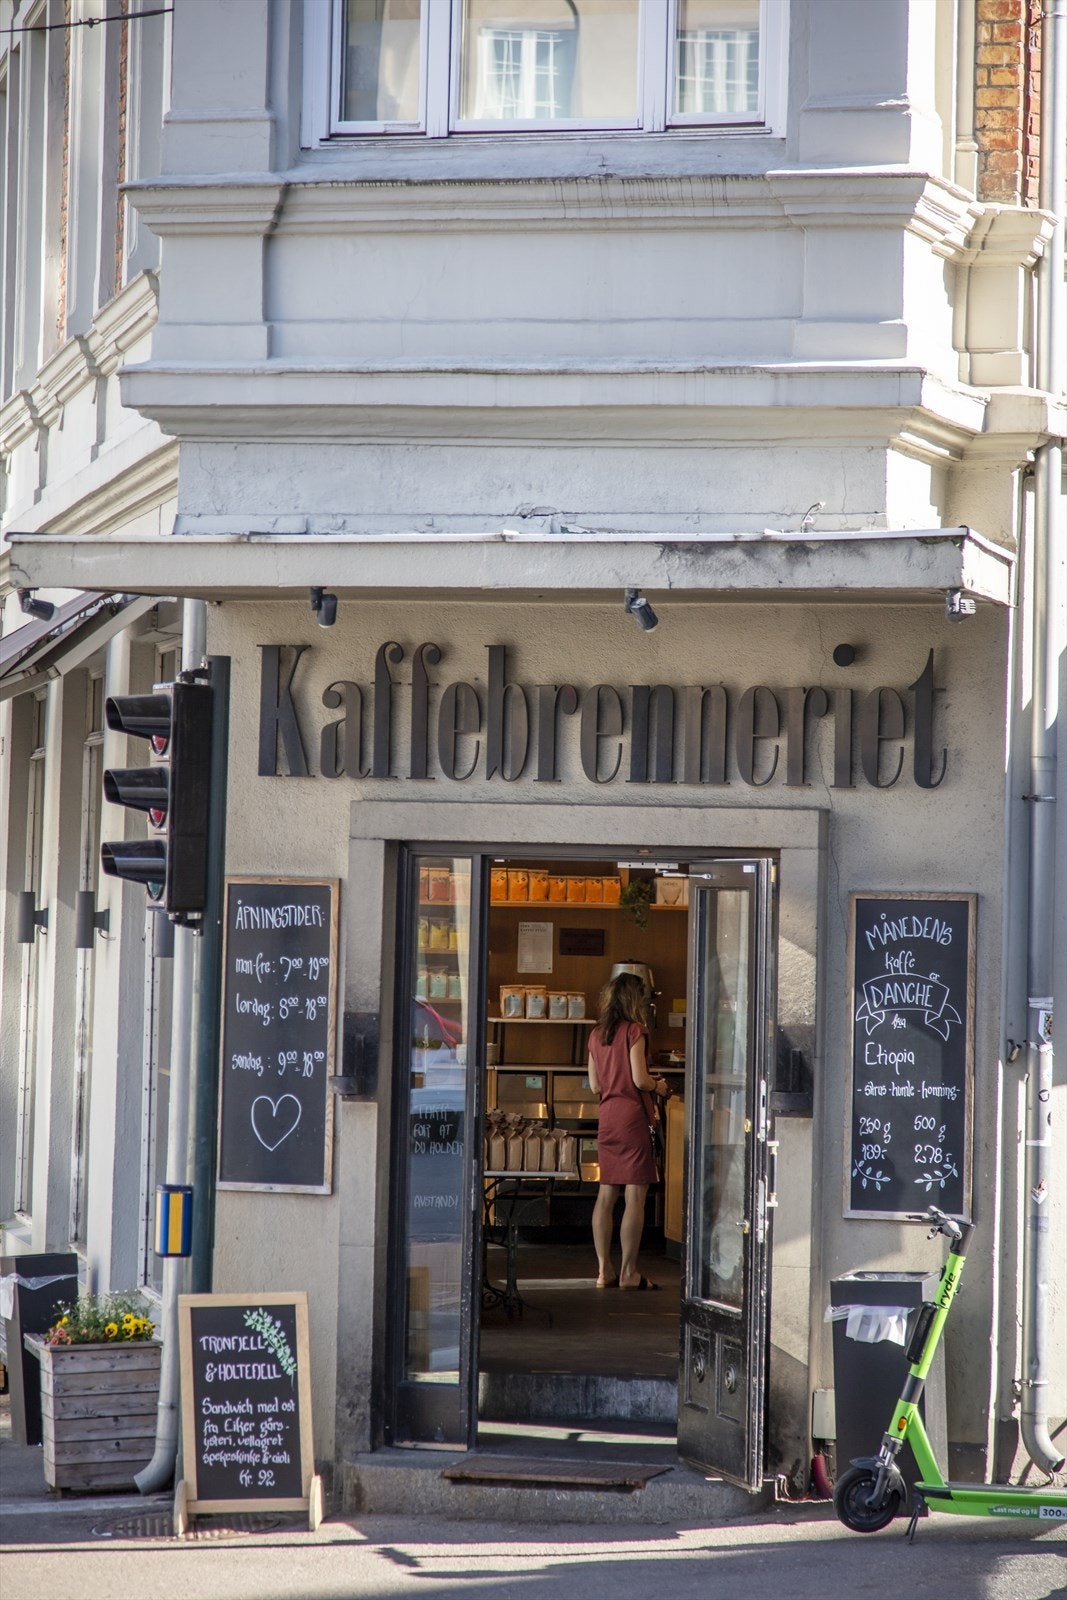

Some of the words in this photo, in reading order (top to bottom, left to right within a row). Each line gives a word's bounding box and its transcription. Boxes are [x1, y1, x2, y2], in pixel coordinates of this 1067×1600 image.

[256, 641, 948, 789] Kaffebrenneriet
[235, 900, 325, 930] ÅPNINGSTIDER:
[865, 913, 953, 951] MÅNEDENS
[885, 950, 915, 976] kaffe
[870, 982, 933, 1008] DANCHE
[865, 1041, 915, 1075] Etiopia
[439, 1123, 454, 1139] AT
[859, 1117, 881, 1136] 250
[883, 1122, 892, 1144] g
[914, 1115, 936, 1131] 500
[938, 1124, 947, 1143] g
[940, 1272, 956, 1306] ryde
[200, 1335, 267, 1354] TRONFJELL
[205, 1363, 218, 1383] &
[202, 1397, 253, 1415] Sandwich
[257, 1396, 279, 1413] med
[281, 1398, 296, 1412] ost
[203, 1419, 219, 1437] fra
[224, 1417, 255, 1436] Eiker
[257, 1469, 276, 1487] 92
[1042, 1507, 1062, 1518] 300
